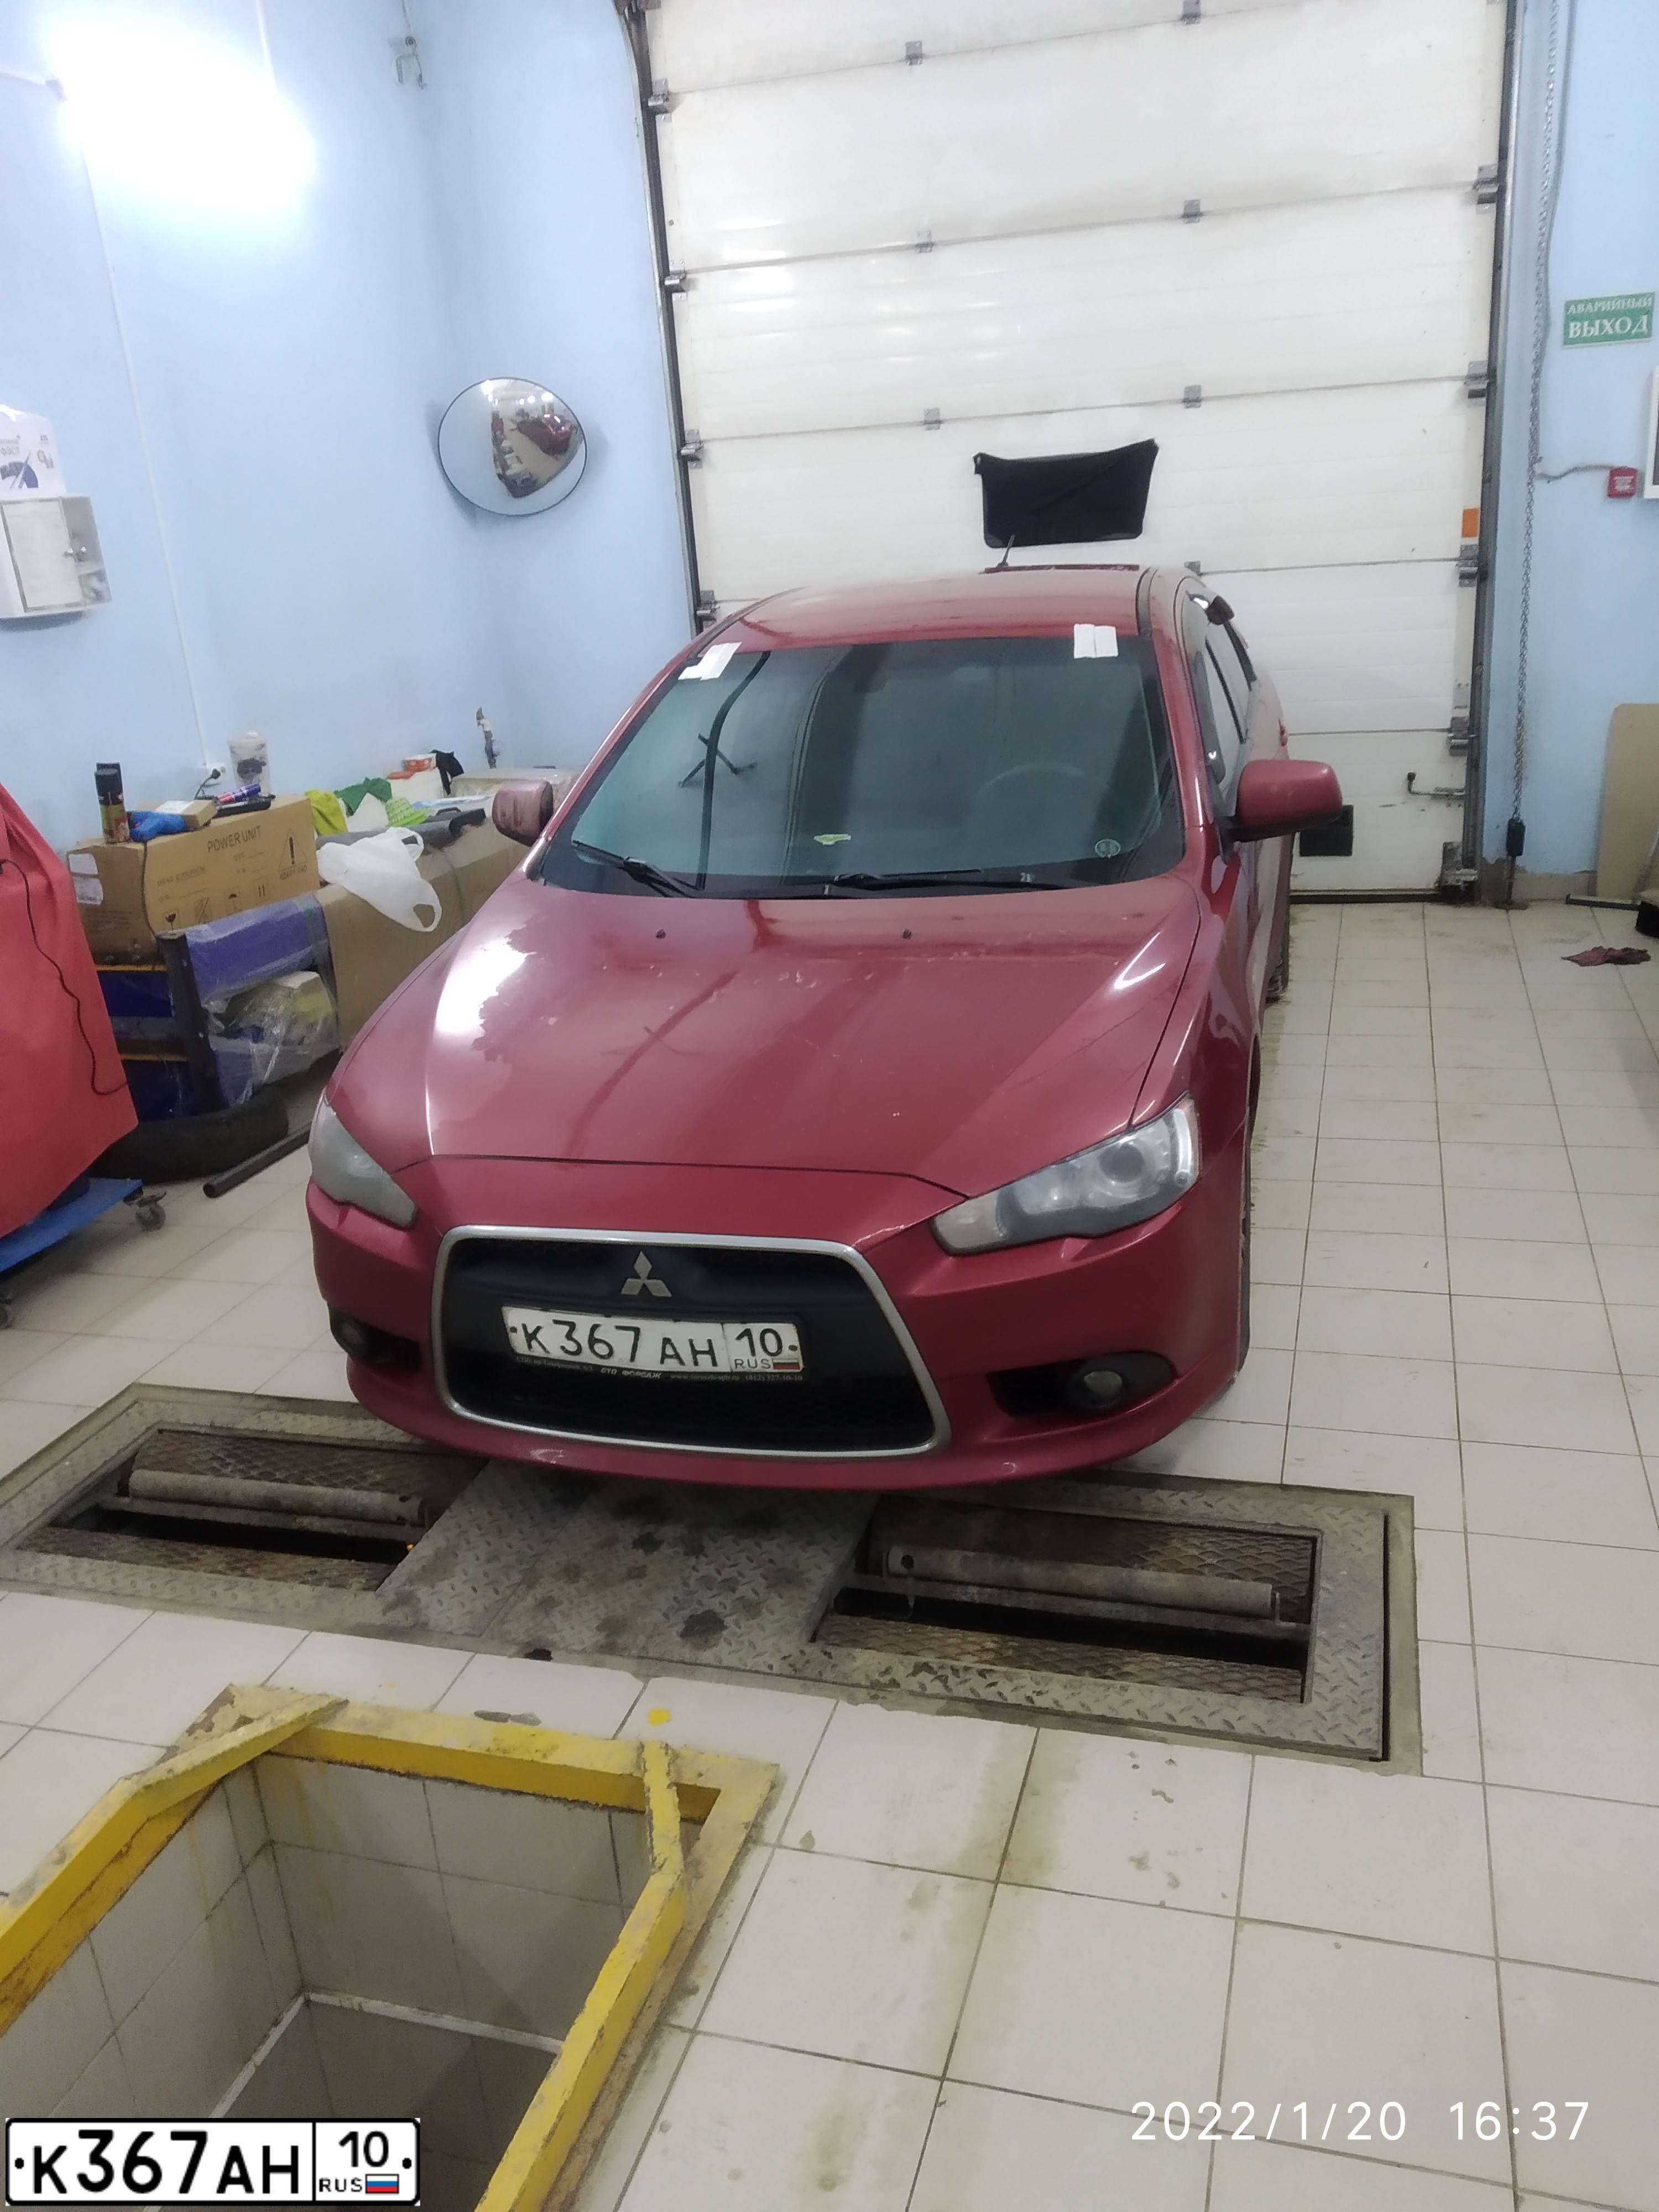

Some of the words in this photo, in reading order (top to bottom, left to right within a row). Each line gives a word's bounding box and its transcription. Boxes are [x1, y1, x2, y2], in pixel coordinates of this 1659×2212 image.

[1567, 294, 1653, 315] АВАРИЙНЫЙ
[1569, 315, 1648, 339] ВЫХОД
[207, 832, 241, 854] POWER
[242, 825, 261, 842] UNIT
[735, 1328, 783, 1357] 10
[601, 1367, 617, 1375] СТО
[622, 1370, 662, 1380] ФОРСАЖ
[734, 1358, 771, 1369] RUS
